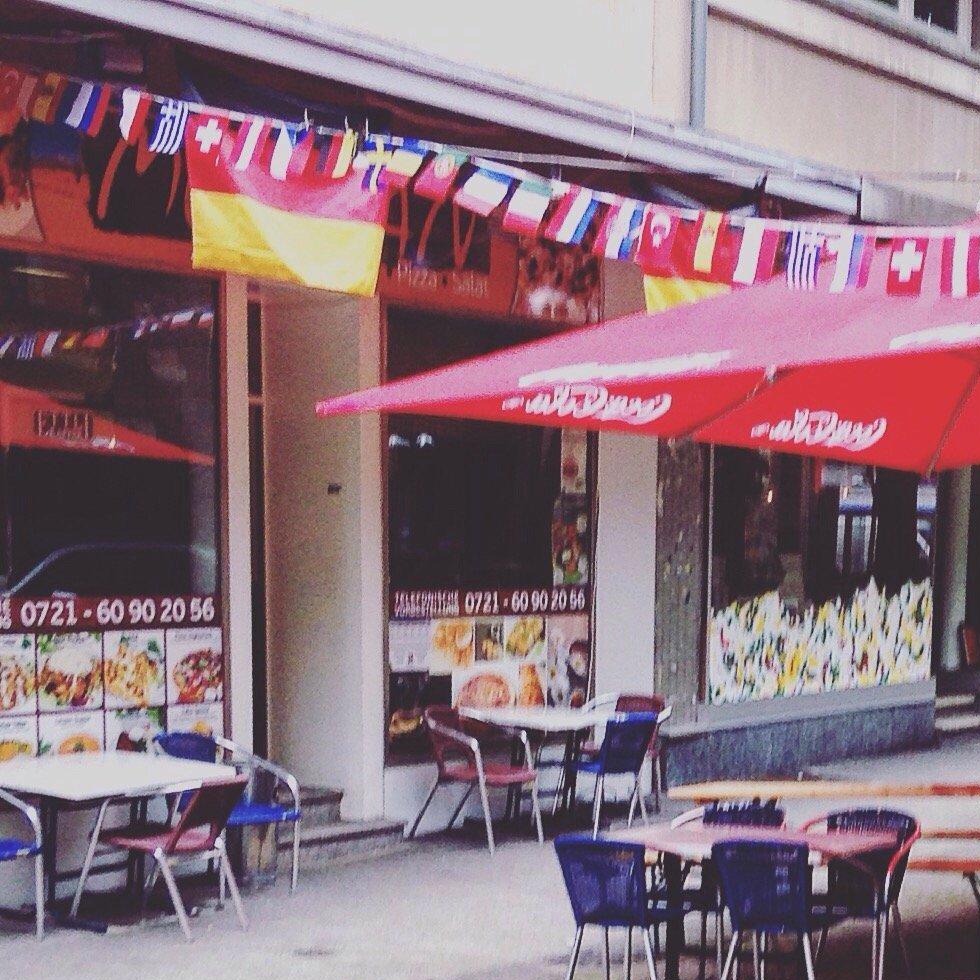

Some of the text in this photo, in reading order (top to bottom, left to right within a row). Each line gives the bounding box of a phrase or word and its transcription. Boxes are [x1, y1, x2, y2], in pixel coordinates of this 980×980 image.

[20, 600, 78, 627] 0721
[97, 599, 125, 625] 60
[128, 598, 156, 624] 90
[160, 597, 186, 623] 20
[465, 590, 499, 614] 0721
[511, 590, 528, 613] 60
[551, 589, 567, 612] 20
